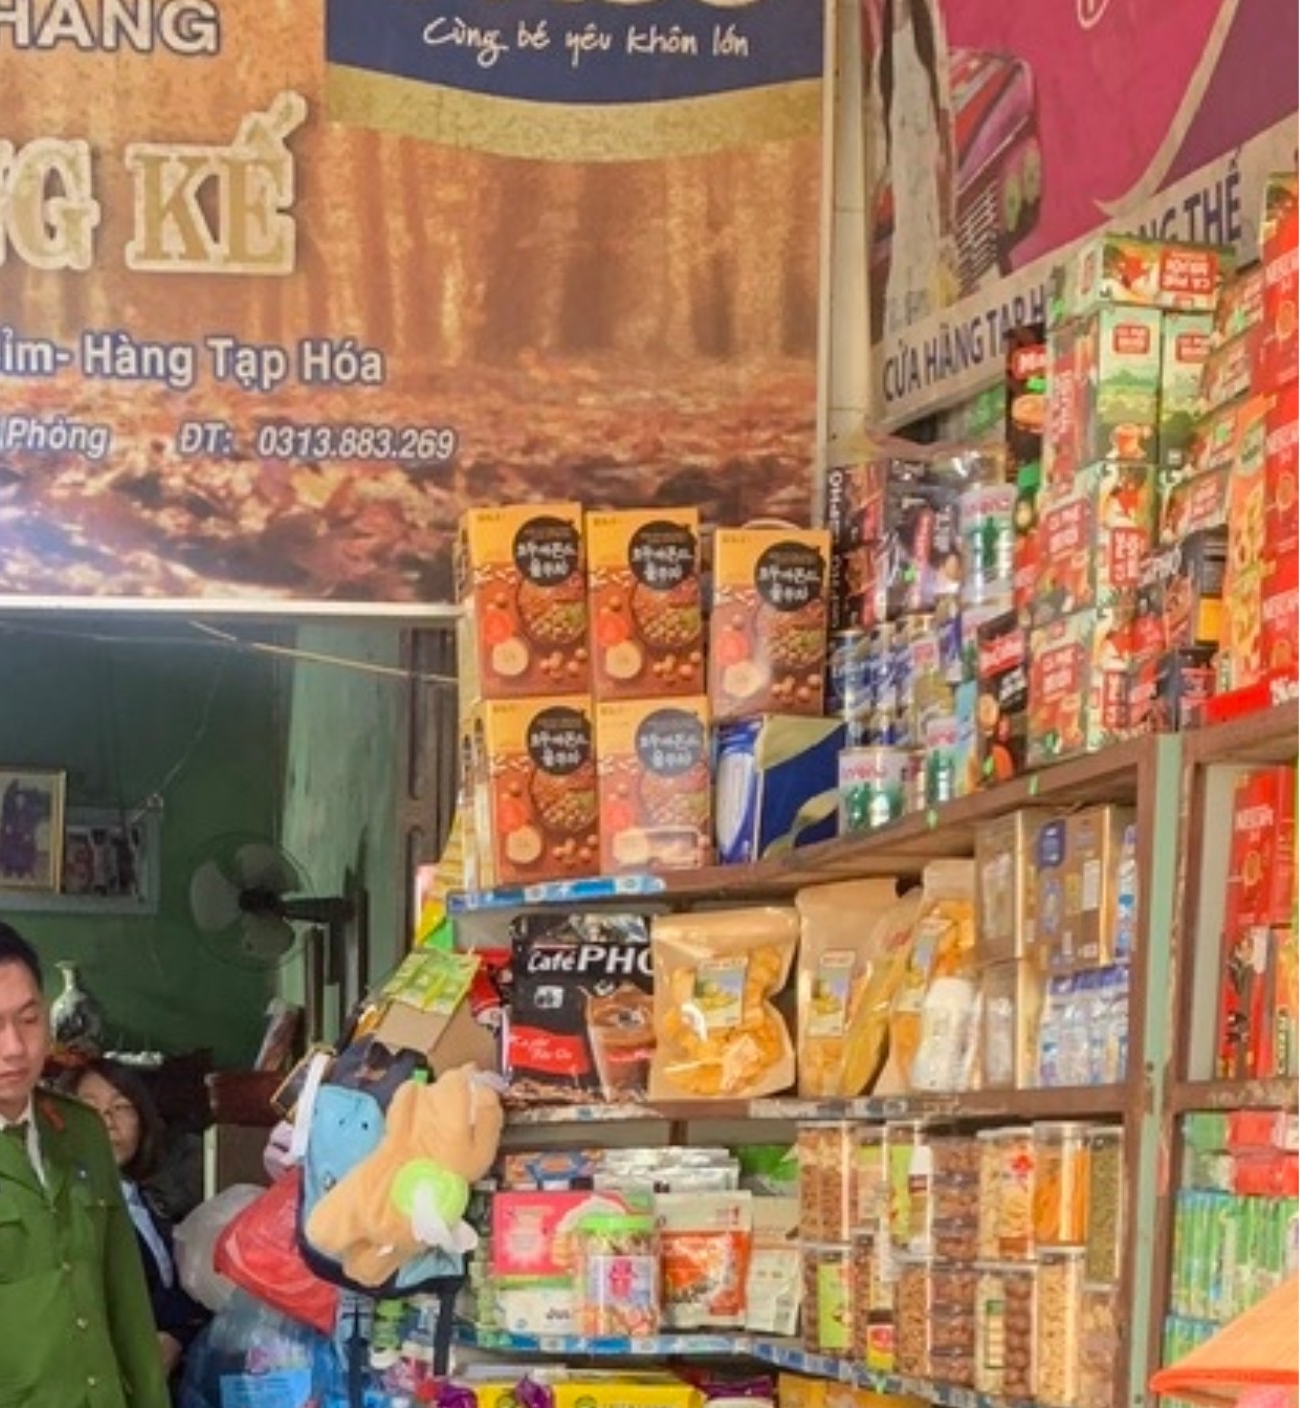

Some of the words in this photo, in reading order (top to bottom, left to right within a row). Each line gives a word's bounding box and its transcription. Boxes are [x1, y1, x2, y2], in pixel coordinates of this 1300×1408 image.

[422, 17, 508, 68] Cùng
[516, 20, 551, 49] bé
[564, 22, 613, 68] yêu
[626, 24, 698, 55] khôn
[712, 23, 749, 57] lớn
[126, 89, 308, 275] KẾ
[83, 329, 194, 383] Hàng
[207, 337, 286, 388] Tạp
[302, 339, 384, 381] Hóa
[4, 416, 110, 457] Phòng
[179, 423, 234, 455] ĐT:
[257, 424, 456, 460] 0313.883.269
